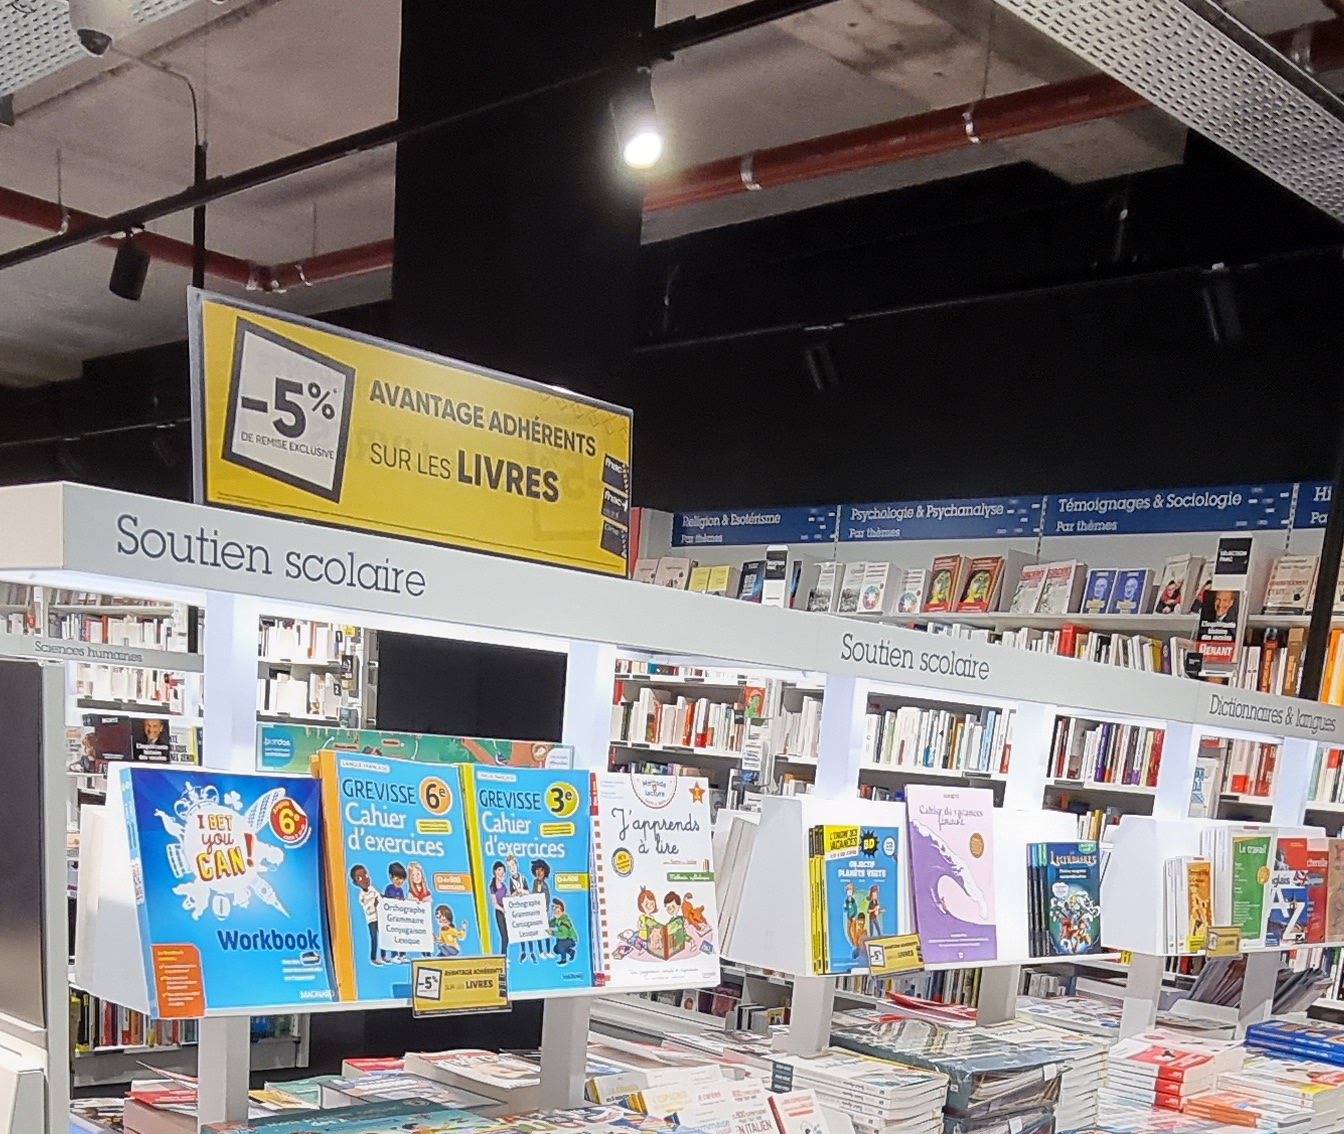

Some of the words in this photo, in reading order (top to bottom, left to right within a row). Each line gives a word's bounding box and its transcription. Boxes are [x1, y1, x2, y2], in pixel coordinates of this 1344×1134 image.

[369, 378, 484, 429] AVANTAGE
[488, 411, 596, 457] ADHÉRENTS
[241, 431, 254, 444] DE
[256, 434, 288, 451] REMISE
[289, 442, 335, 460] EXCLUSIVE
[369, 443, 413, 472] SUR
[416, 453, 452, 480] LES
[457, 450, 560, 503] LIVRES
[850, 505, 915, 522] Psychologie
[916, 504, 925, 517] &
[926, 502, 1004, 518] Psychanalyse
[1058, 496, 1153, 514] Témoignages
[1155, 493, 1165, 508] &
[1166, 492, 1242, 509] Sociologie
[682, 513, 719, 529] Religion
[720, 514, 730, 526] &
[1056, 521, 1074, 531] Par
[1076, 519, 1118, 531] thèmes
[117, 514, 272, 575] Soutien
[285, 551, 426, 597] scolaire
[35, 641, 84, 657] Sciences
[86, 647, 143, 663] humaines
[841, 633, 914, 669] Soutien
[919, 651, 990, 680] scolaire
[1209, 694, 1283, 725] Dictionnaires
[1285, 706, 1293, 726] &
[1295, 708, 1337, 735] langues
[342, 778, 417, 805] GREVISSE
[425, 782, 446, 809] 6e
[479, 788, 542, 811] GREVISSE
[550, 786, 573, 813] 3e
[197, 814, 205, 830] I
[208, 814, 233, 832] BET
[345, 801, 407, 827] Cahier
[481, 811, 532, 835] Cahier
[611, 807, 701, 841] J'apprends
[201, 832, 234, 854] you
[348, 828, 445, 857] d'exercices
[485, 835, 566, 859] d'exercices
[638, 839, 649, 855] à
[655, 834, 680, 855] lire
[1239, 843, 1247, 854] Le
[383, 903, 426, 919] Orthographe
[508, 899, 541, 910] Orthographe
[386, 925, 427, 937] Conjugaison
[387, 915, 425, 926] Grammaire
[217, 928, 322, 951] Workbook
[394, 936, 420, 946] Lexique
